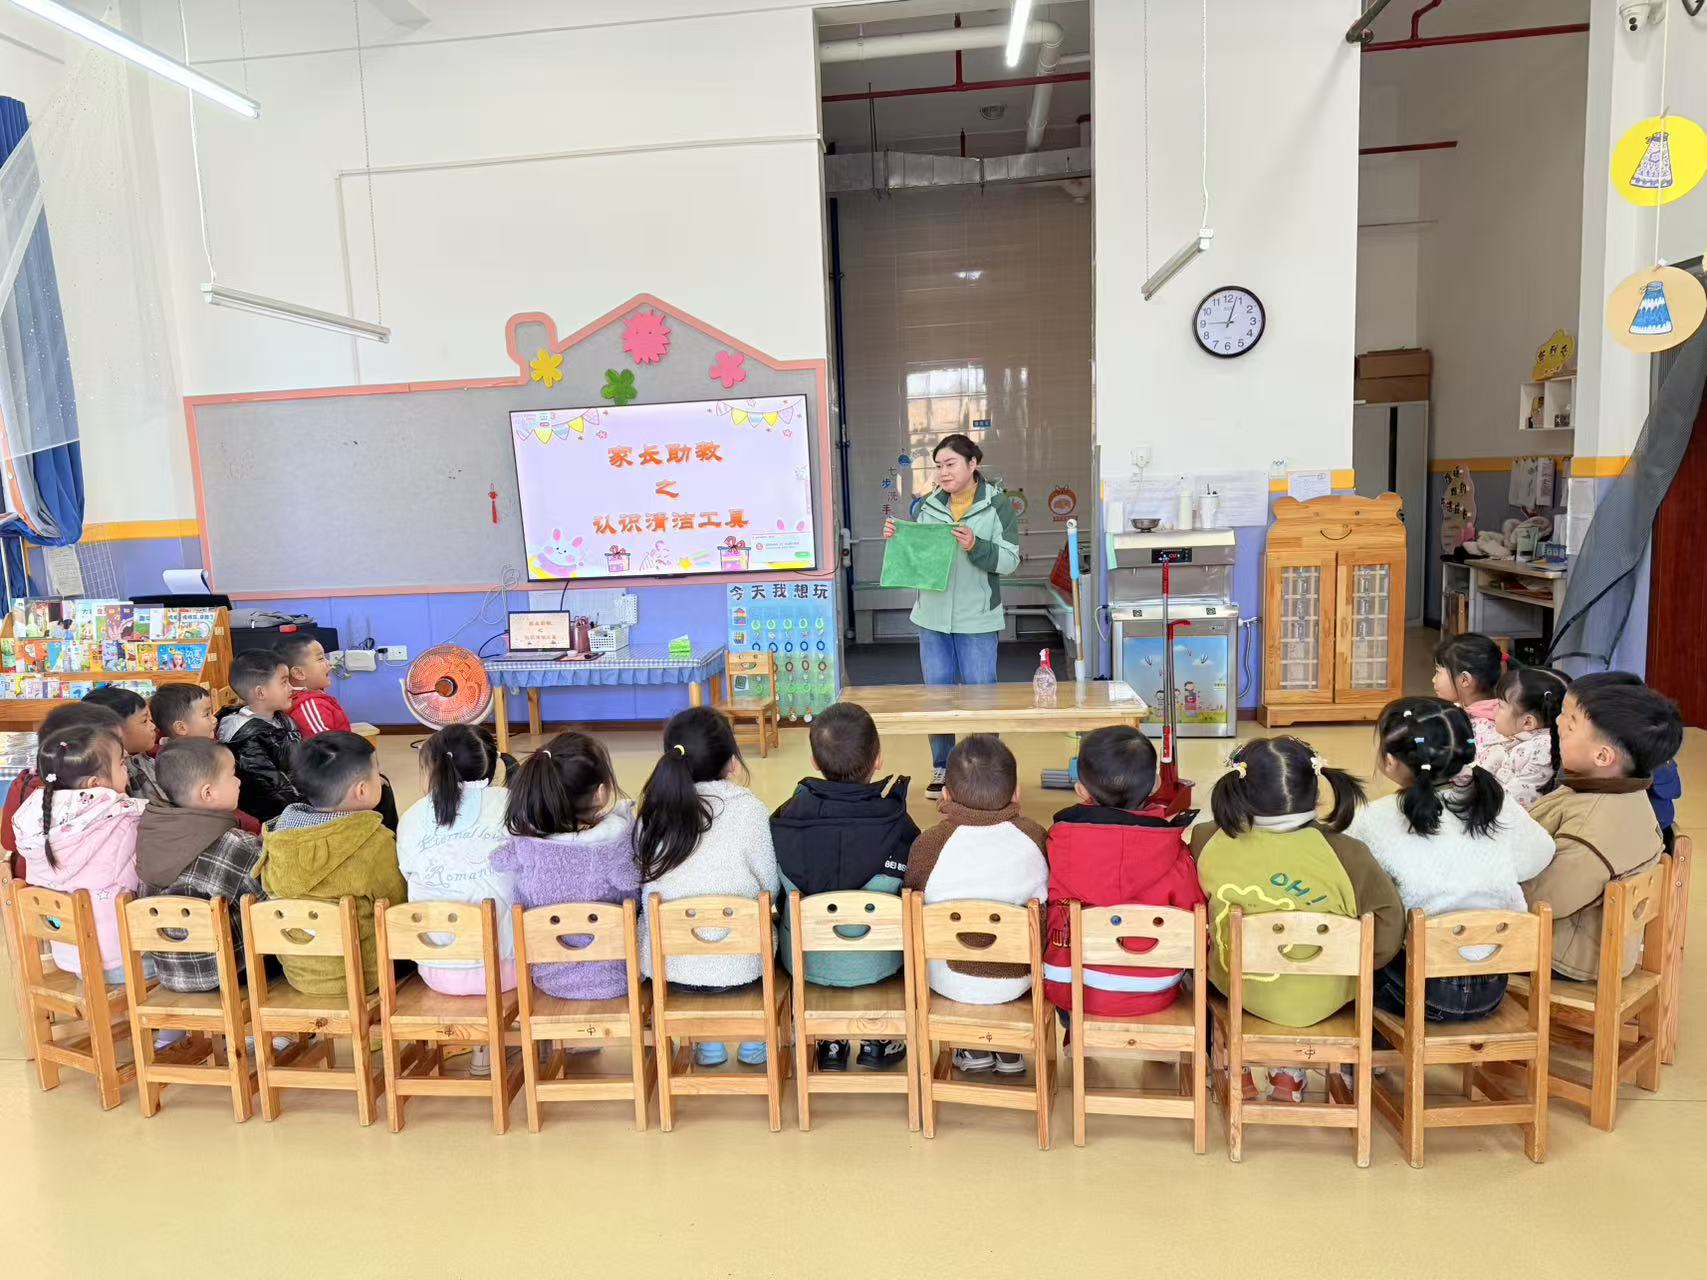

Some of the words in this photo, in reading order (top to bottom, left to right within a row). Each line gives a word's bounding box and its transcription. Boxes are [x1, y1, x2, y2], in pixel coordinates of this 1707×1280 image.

[1212, 298, 1220, 306] 11
[1224, 294, 1234, 304] 12
[1239, 297, 1243, 305] 1
[1204, 307, 1212, 316] 10
[1246, 305, 1253, 314] 2
[1200, 320, 1207, 328] 9
[1250, 317, 1257, 326] 3
[1204, 331, 1210, 340] 8
[1247, 329, 1253, 337] 4
[1213, 340, 1219, 349] 7
[1225, 342, 1231, 351] 6
[1238, 339, 1244, 347] 5
[607, 441, 724, 468] 家长助教
[655, 478, 680, 499] 之
[592, 508, 750, 536] 认识清洁工具
[729, 583, 829, 600] 今天我想玩
